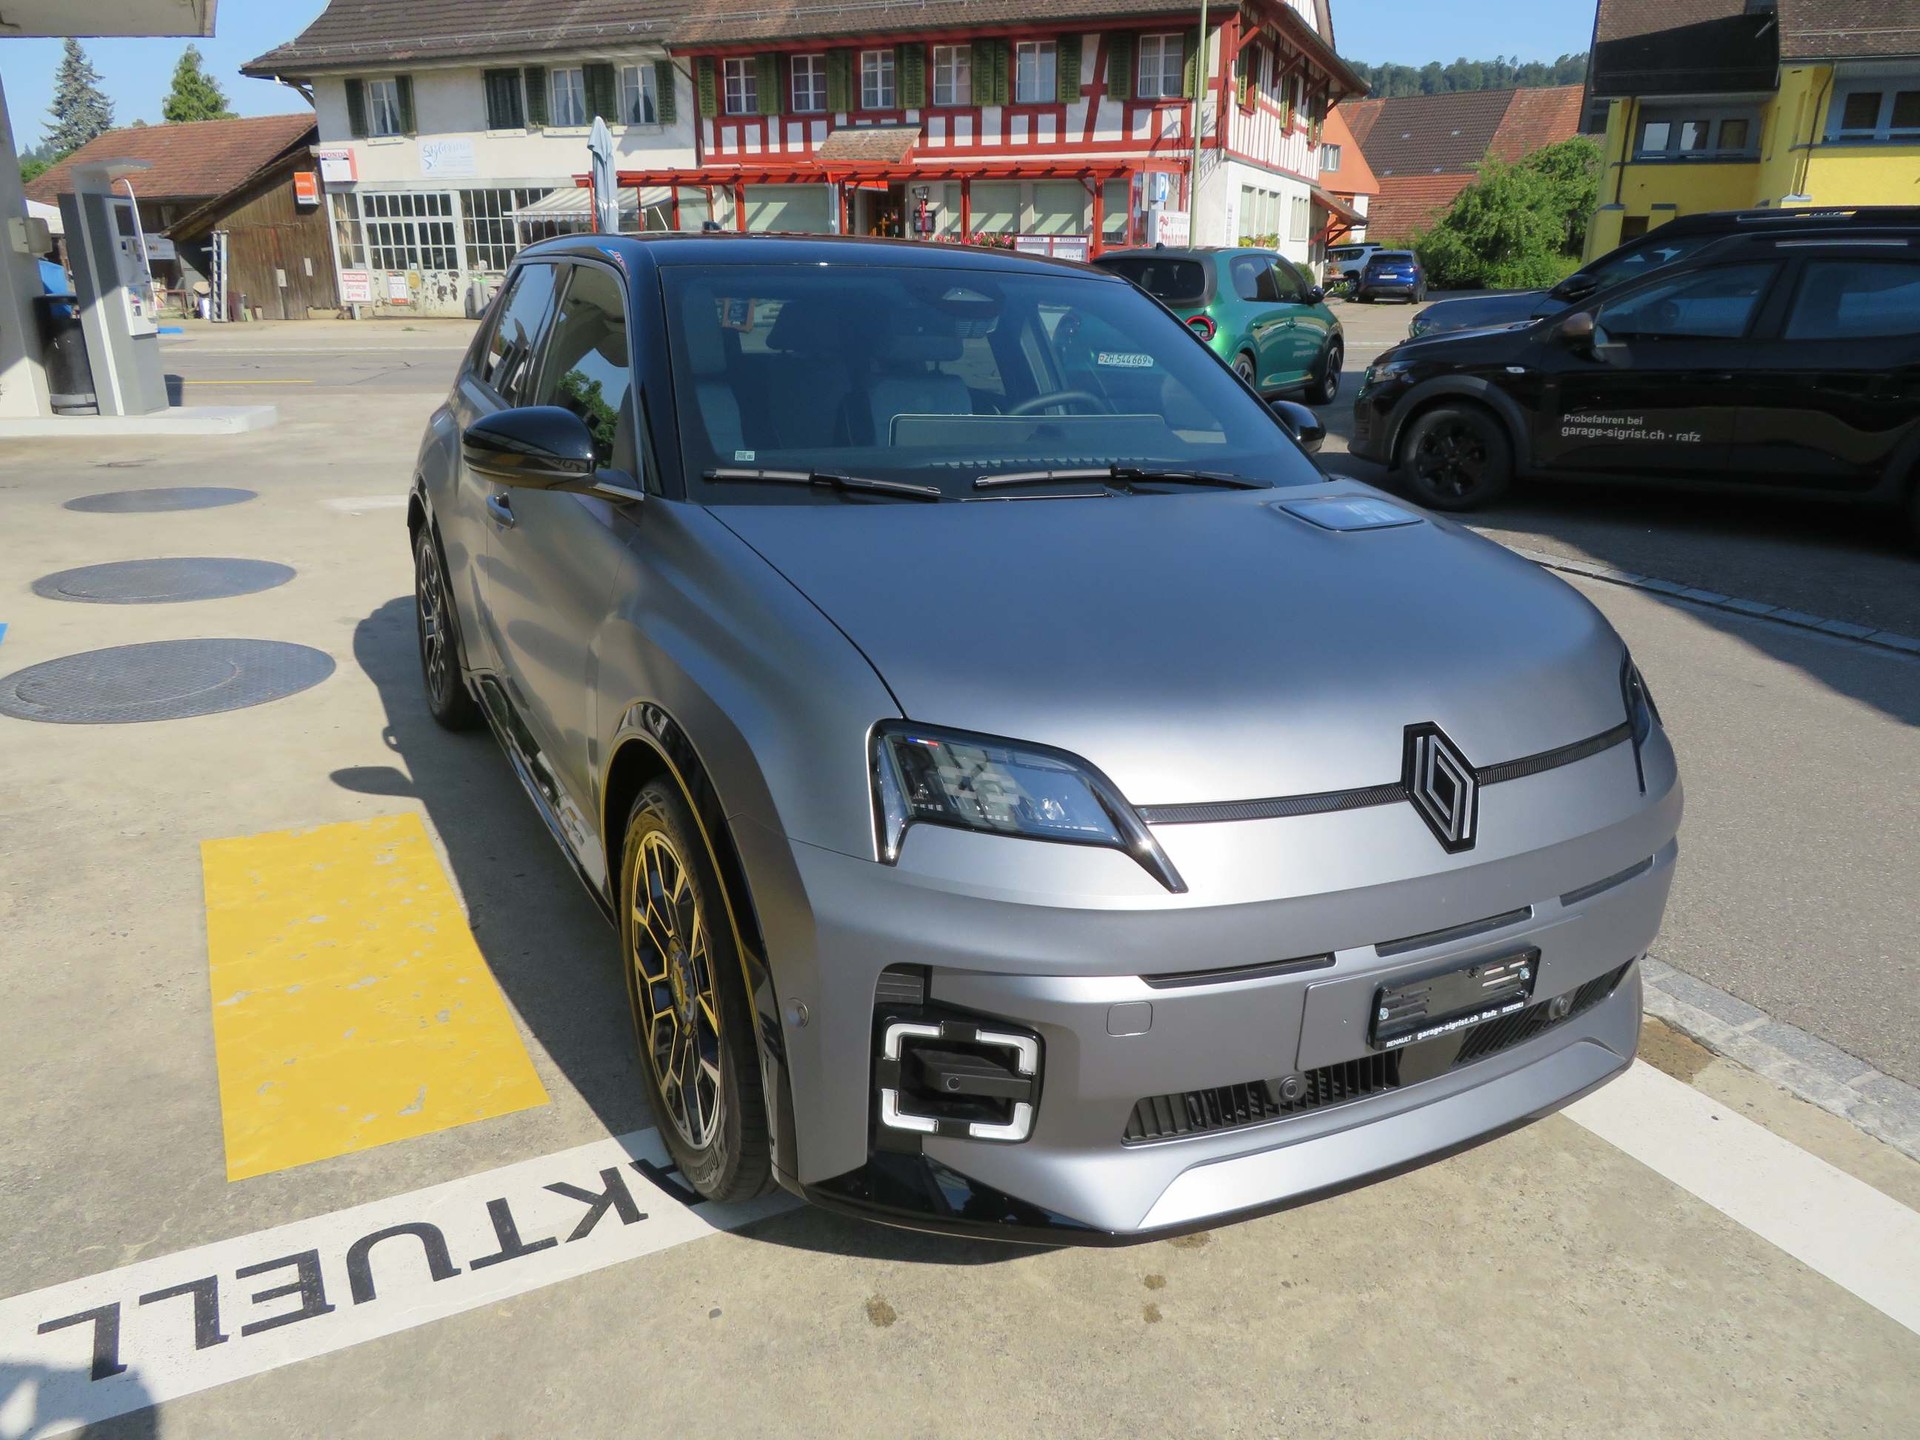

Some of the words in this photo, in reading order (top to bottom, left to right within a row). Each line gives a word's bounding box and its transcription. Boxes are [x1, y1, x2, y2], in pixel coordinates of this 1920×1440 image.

[1563, 414, 1625, 425] Probefahren
[1627, 416, 1643, 426] bei
[1561, 426, 1665, 440] garage-sigrist.ch
[1676, 432, 1702, 442] rafz
[1386, 1035, 1413, 1048] RENAULT
[1417, 1015, 1479, 1040] garage-sigrist.ch
[1482, 1010, 1498, 1020] Rafz
